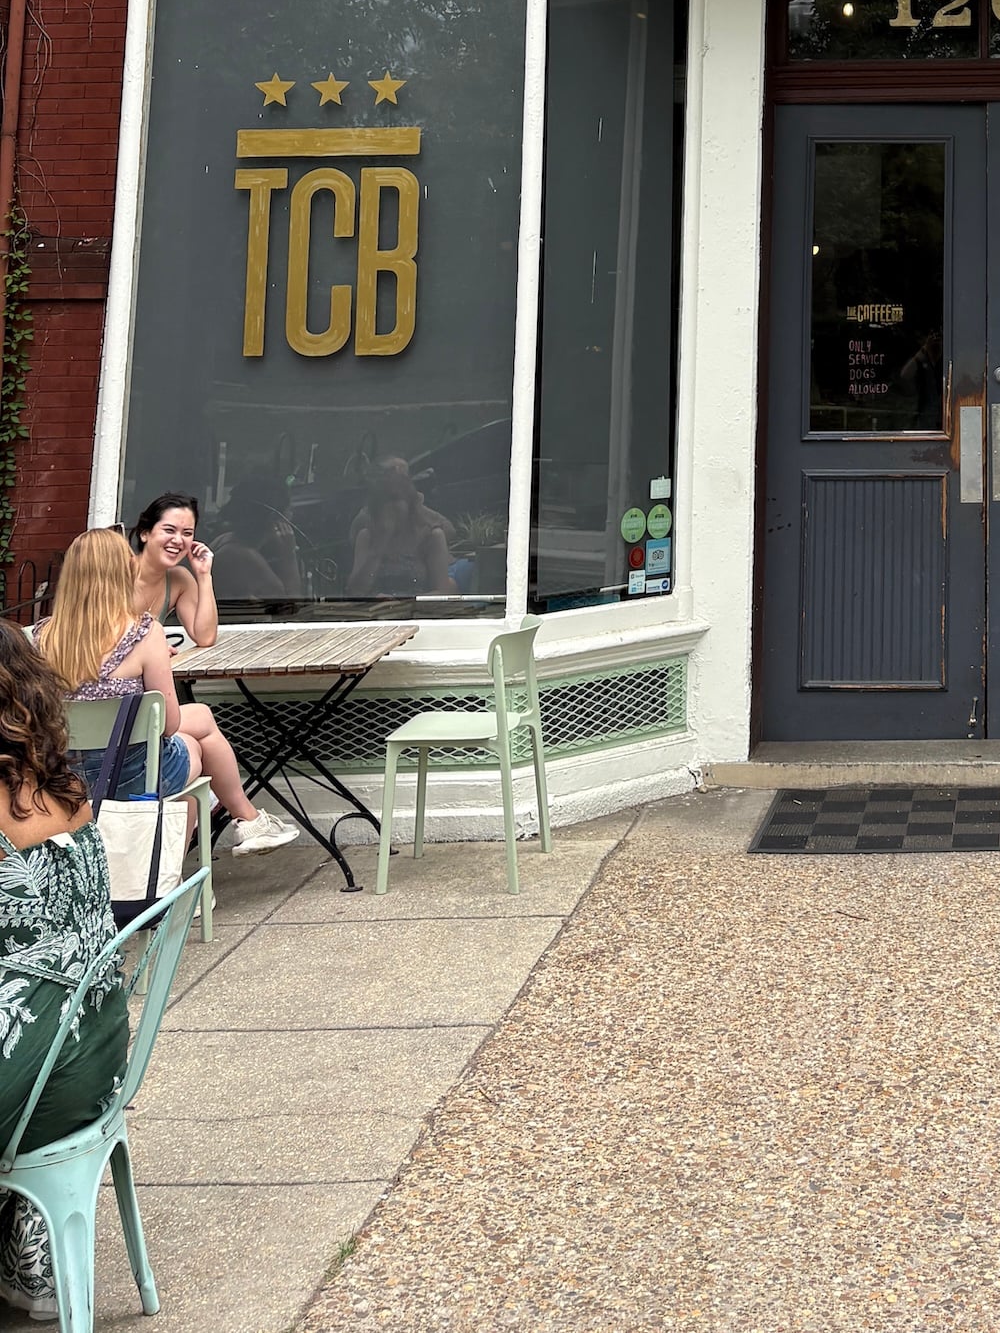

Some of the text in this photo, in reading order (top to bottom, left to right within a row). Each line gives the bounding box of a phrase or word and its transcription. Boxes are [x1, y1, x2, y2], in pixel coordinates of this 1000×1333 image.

[234, 167, 421, 357] TCB
[857, 304, 891, 322] COFFEE
[849, 339, 871, 353] ONLY
[850, 368, 876, 380] DOGS
[848, 383, 889, 395] ALLOWED
